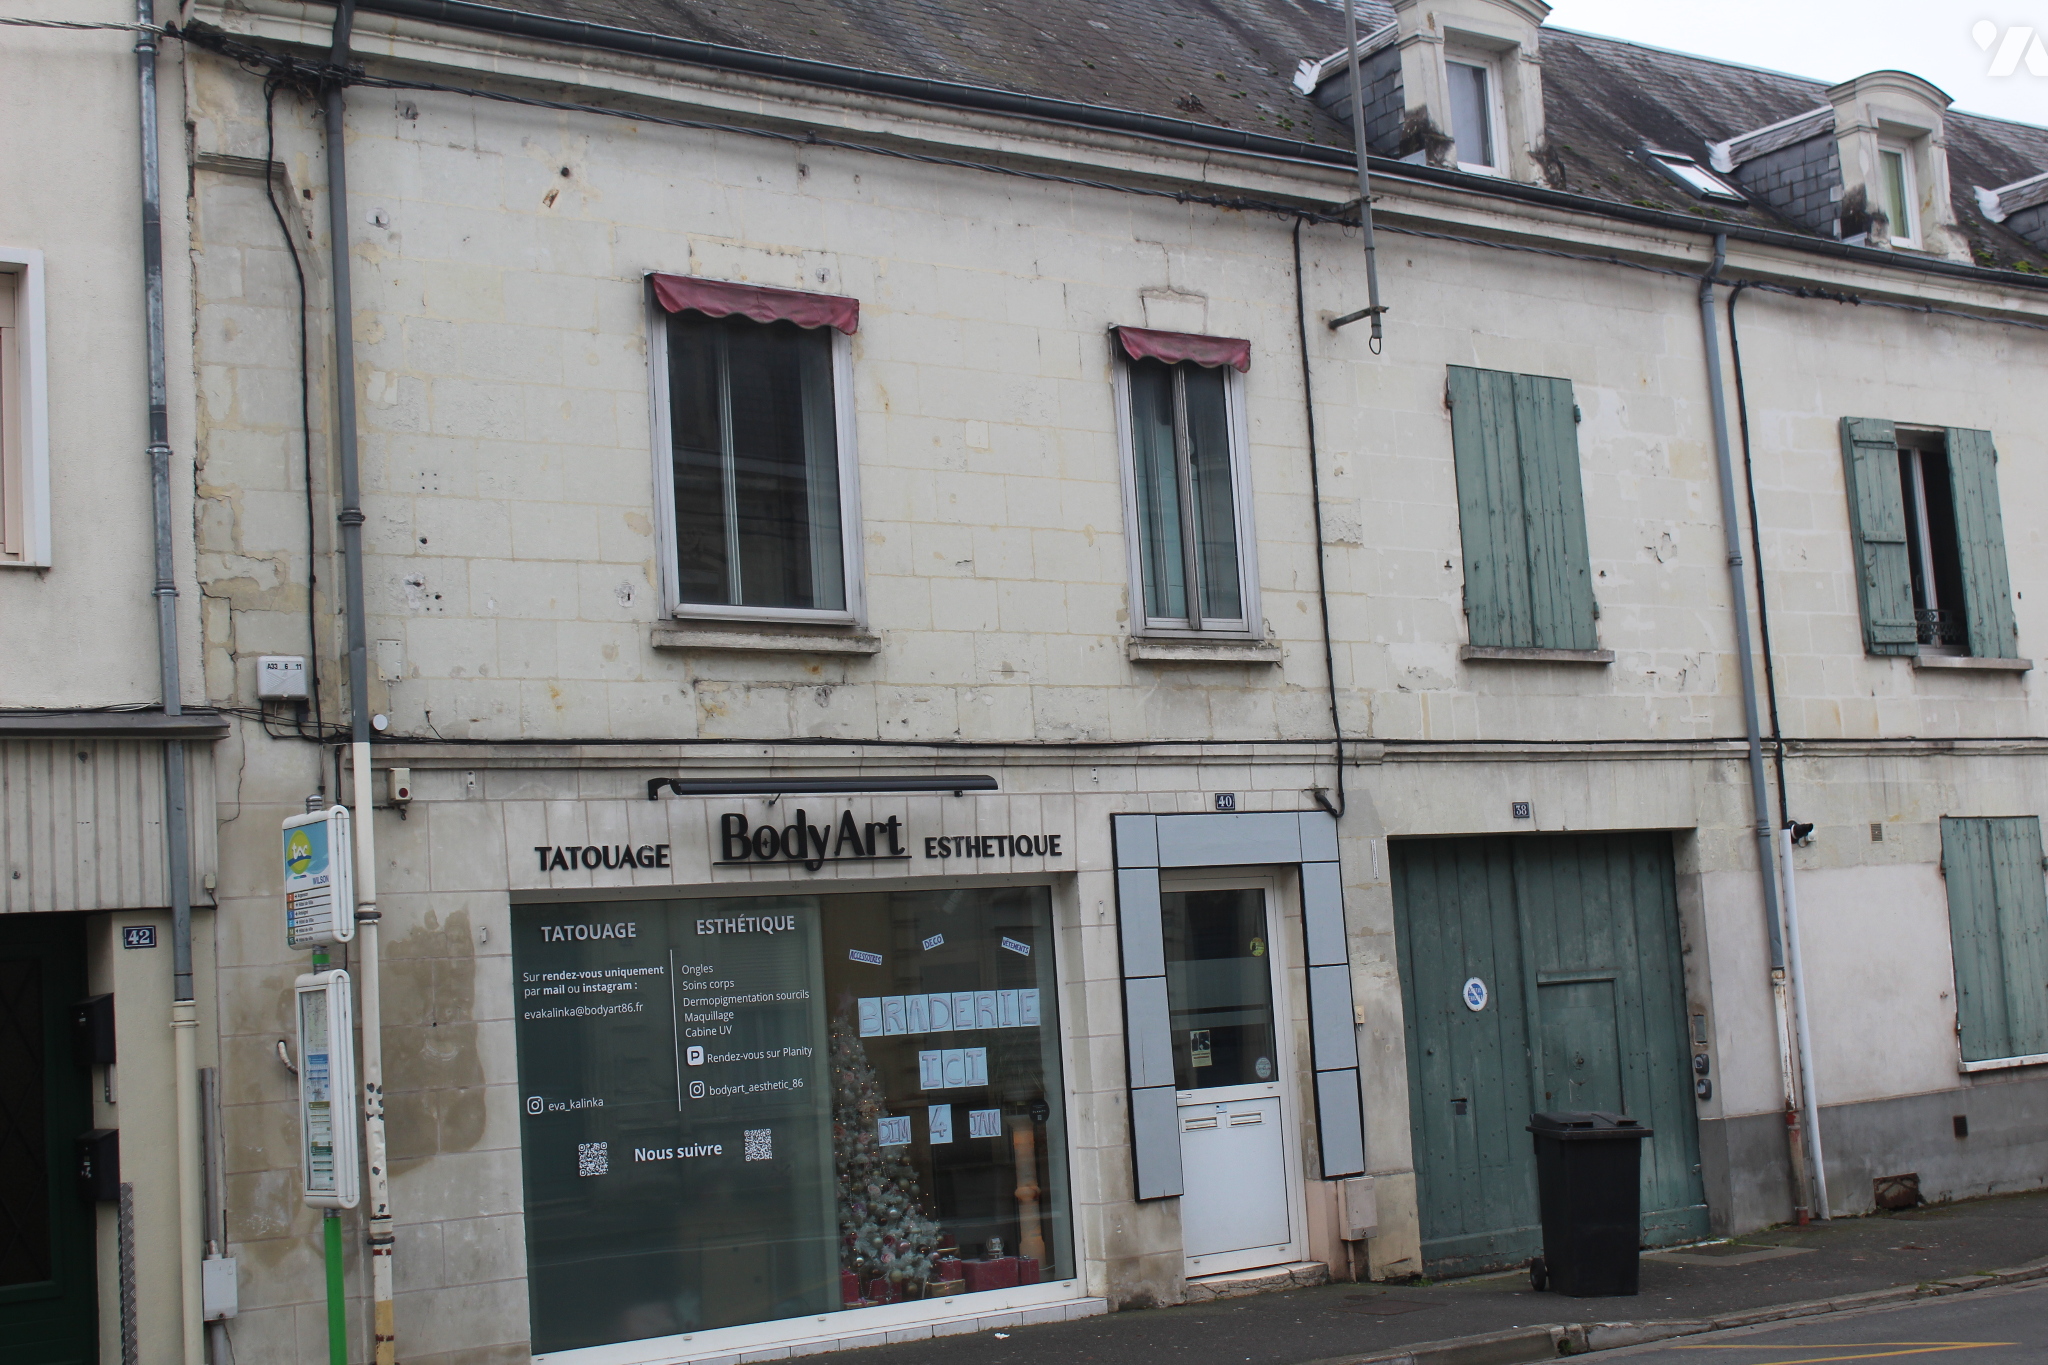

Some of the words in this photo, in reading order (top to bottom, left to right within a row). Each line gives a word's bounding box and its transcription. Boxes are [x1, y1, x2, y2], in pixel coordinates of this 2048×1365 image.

[1218, 795, 1233, 808] 40
[1515, 804, 1528, 816] 38
[720, 808, 906, 872] BodyArt
[924, 834, 1063, 859] ESTHETIQUE
[534, 843, 671, 872] TATOUAGE
[313, 875, 329, 884] WILSON
[540, 922, 637, 943] TATOUAGE
[696, 913, 796, 936] ESTHÉTIQUE
[128, 929, 150, 945] 42
[523, 971, 541, 983] Sur
[542, 968, 603, 981] rendez-vous
[604, 965, 664, 979] uniquement
[682, 963, 714, 976] Ongles
[524, 987, 541, 999] par
[543, 984, 566, 996] mail
[567, 985, 580, 994] ou
[582, 980, 633, 995] instagram
[682, 980, 707, 991] Soins
[709, 979, 735, 991] corps
[683, 992, 774, 1007] Dermopigmentation
[776, 989, 810, 1001] sourcils
[524, 1002, 644, 1020] evakalinka@bodyart86.fr
[684, 1010, 735, 1024] Maquillage
[859, 990, 1039, 1035] BRADERIE
[685, 1026, 717, 1038] Cabine
[719, 1025, 733, 1036] UV
[707, 1050, 765, 1064] Rendez-vous
[766, 1049, 781, 1059] sur
[783, 1045, 813, 1060] Planity
[921, 1049, 987, 1088] ICI
[709, 1078, 804, 1097] bodyart_aesthetic_86
[548, 1097, 604, 1113] eva_kalinka
[878, 1120, 911, 1144] DIM
[930, 1106, 948, 1138] 4
[970, 1110, 1000, 1136] JAN
[634, 1146, 673, 1162] Nous
[677, 1142, 723, 1159] suivre
